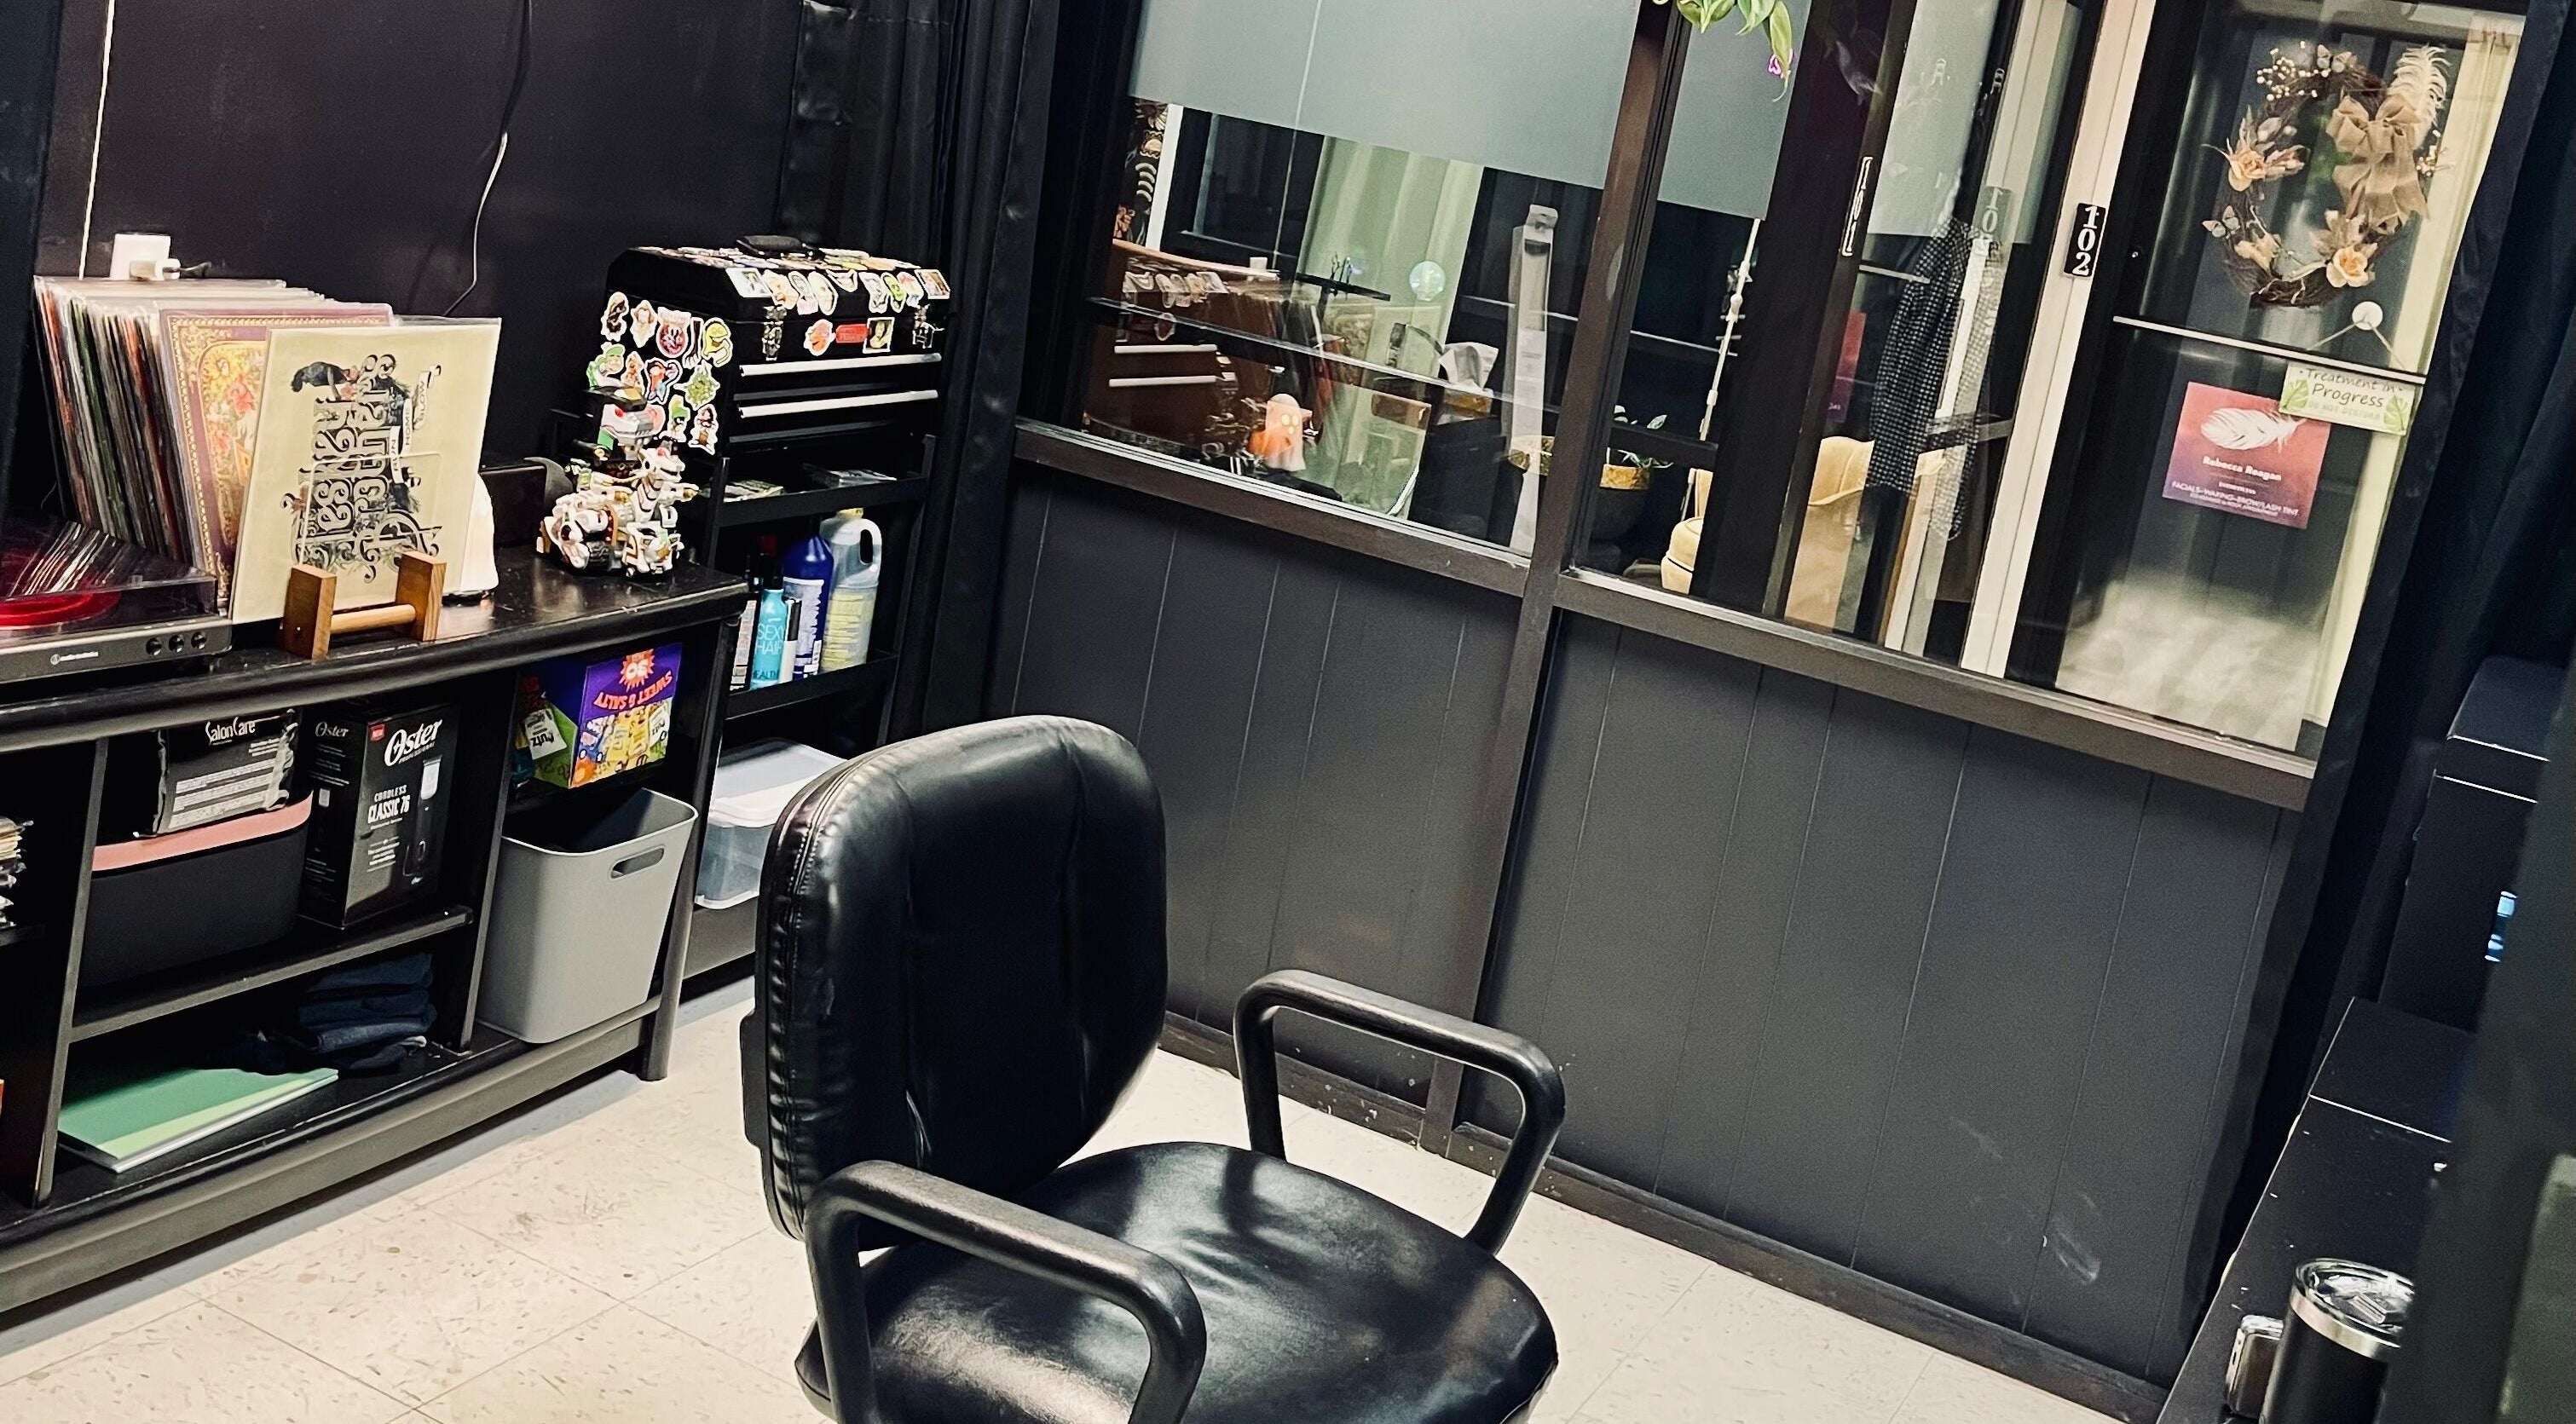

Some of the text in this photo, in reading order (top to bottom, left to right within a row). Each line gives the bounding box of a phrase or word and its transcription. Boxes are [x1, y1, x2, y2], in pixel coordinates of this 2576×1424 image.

[2071, 205, 2099, 276] 102
[2306, 368, 2378, 391] Treatment
[2312, 383, 2385, 408] Progress
[402, 407, 411, 447] HOME
[390, 439, 399, 472] RUN
[2203, 456, 2282, 481] Rebecca Reagan
[593, 692, 628, 710] SALTY
[638, 671, 673, 706] SWEET
[315, 721, 349, 738] Oster
[384, 719, 442, 766] Oster
[367, 798, 400, 823] CLASSIC
